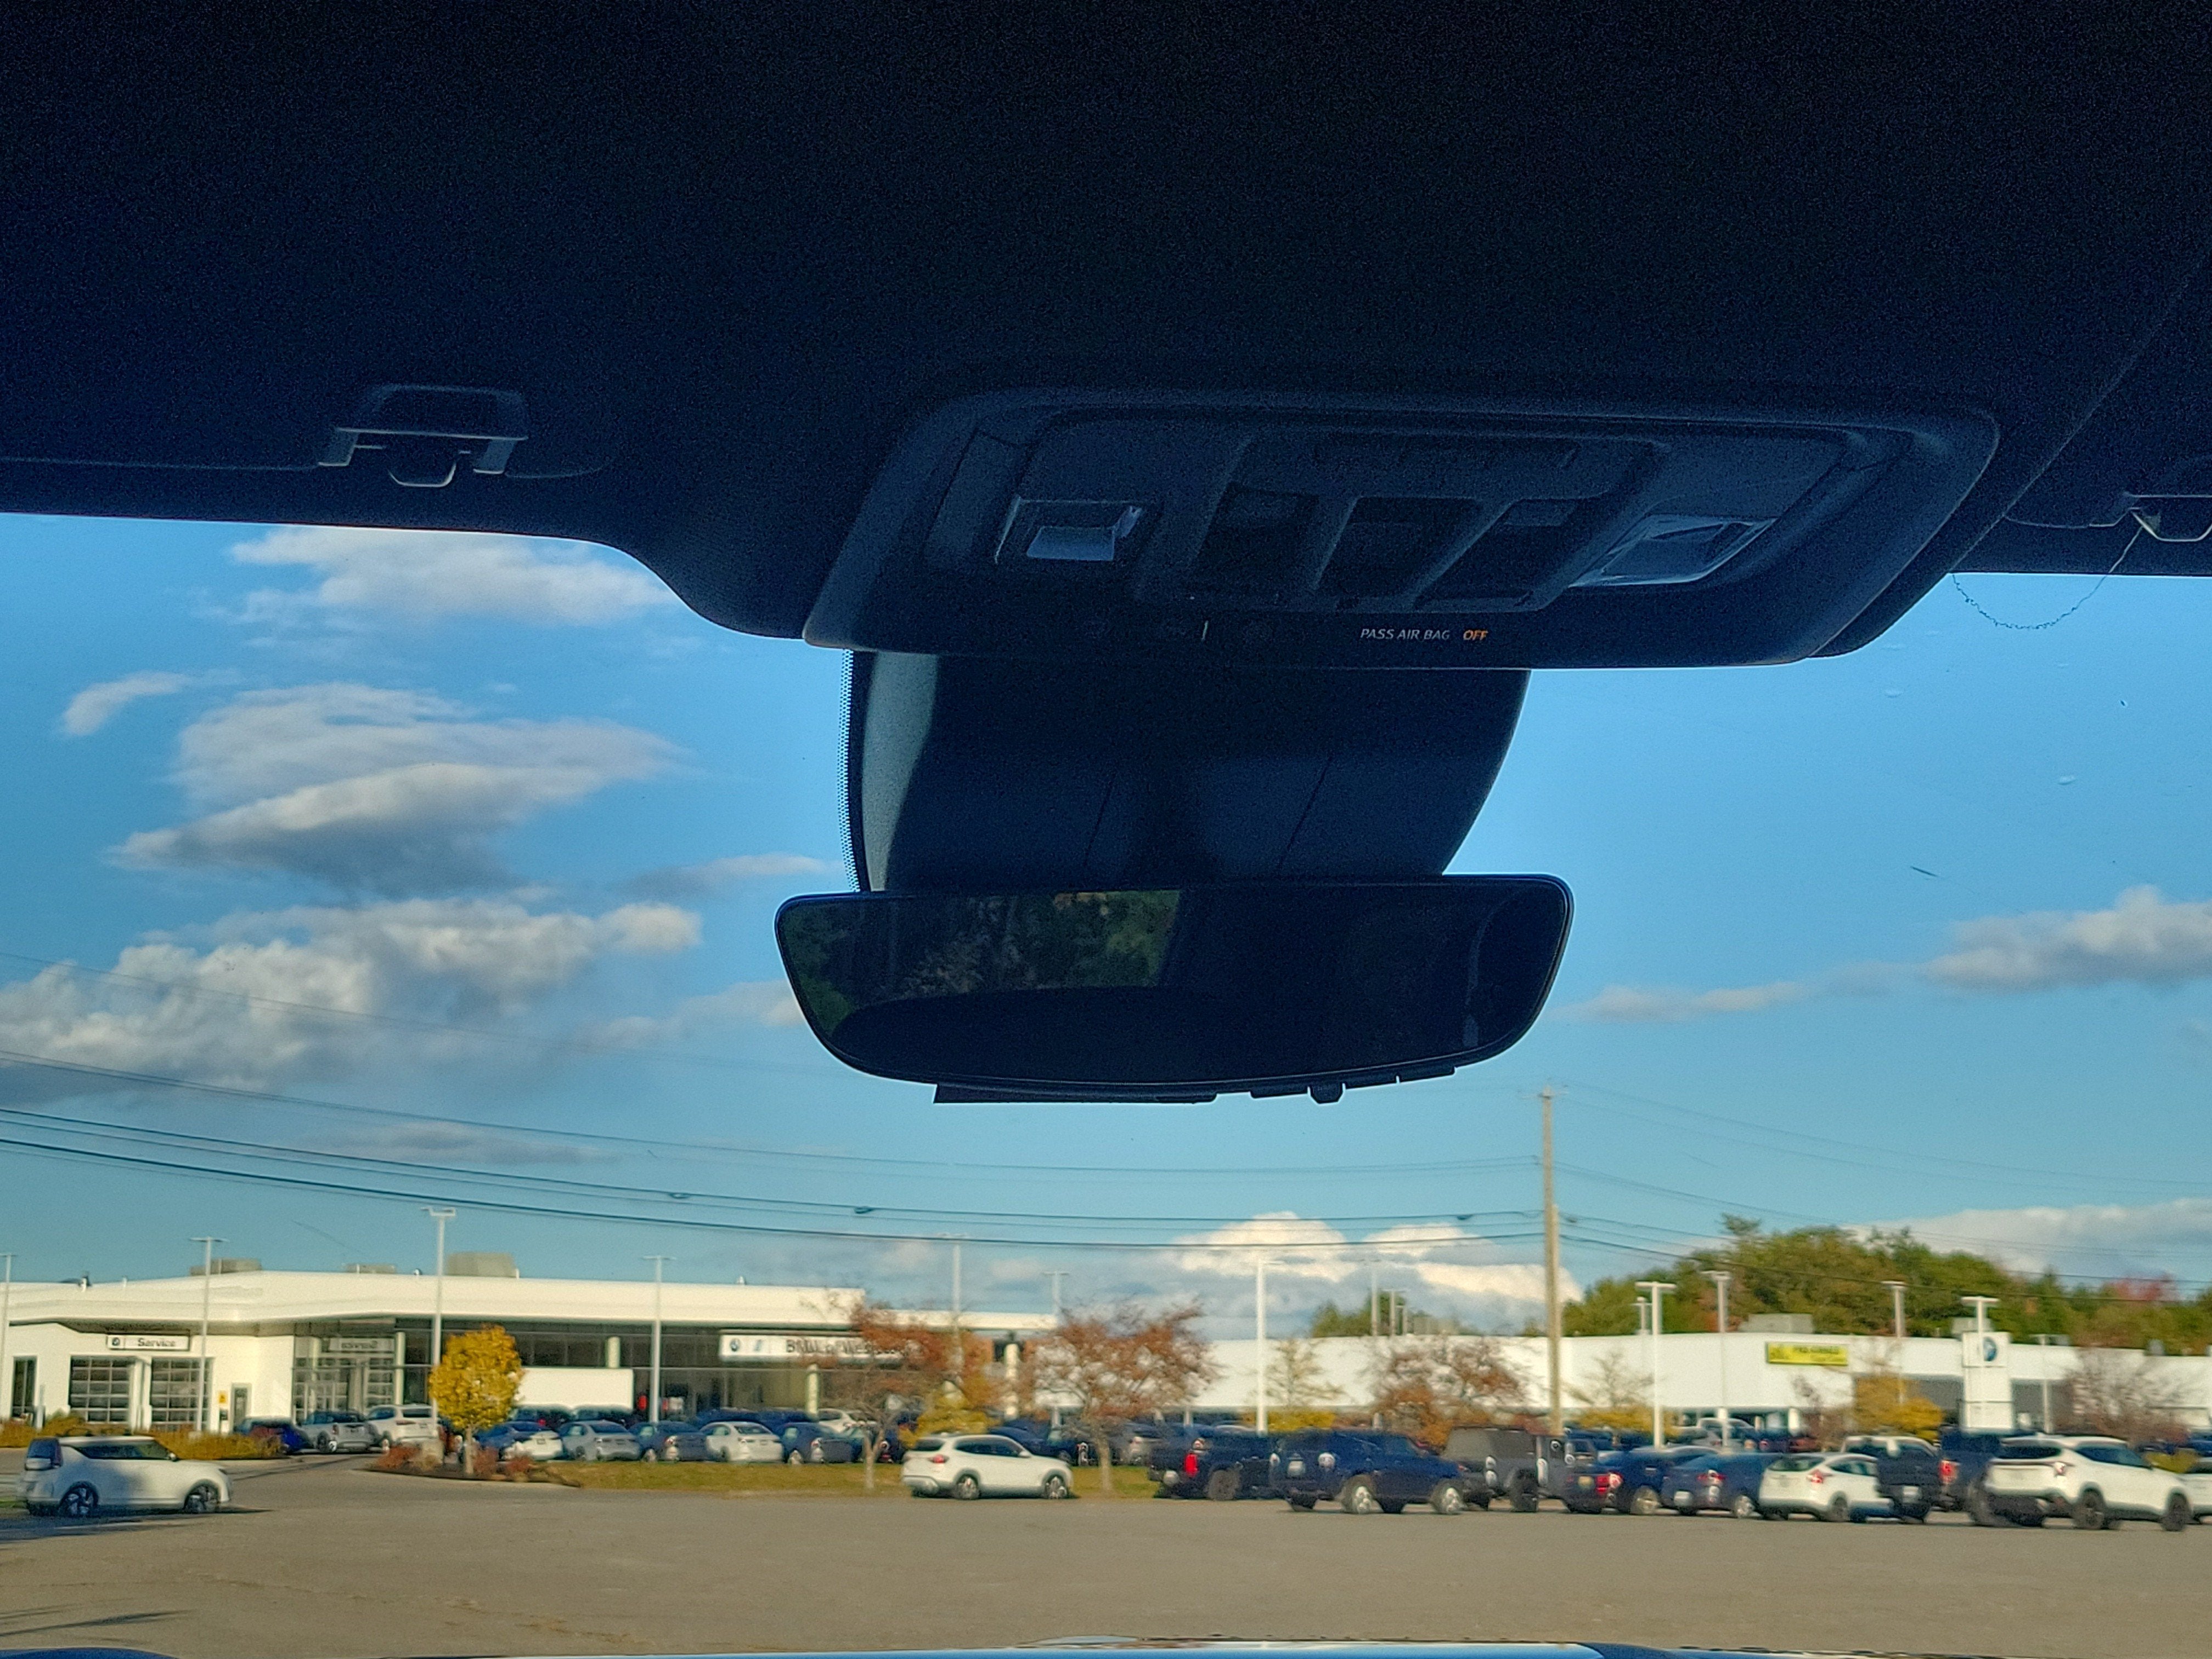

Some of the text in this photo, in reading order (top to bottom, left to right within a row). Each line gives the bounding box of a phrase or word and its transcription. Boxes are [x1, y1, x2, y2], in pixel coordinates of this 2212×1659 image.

[1360, 628, 1488, 641] PASS AIR BAG OFF
[138, 1338, 176, 1347] Service
